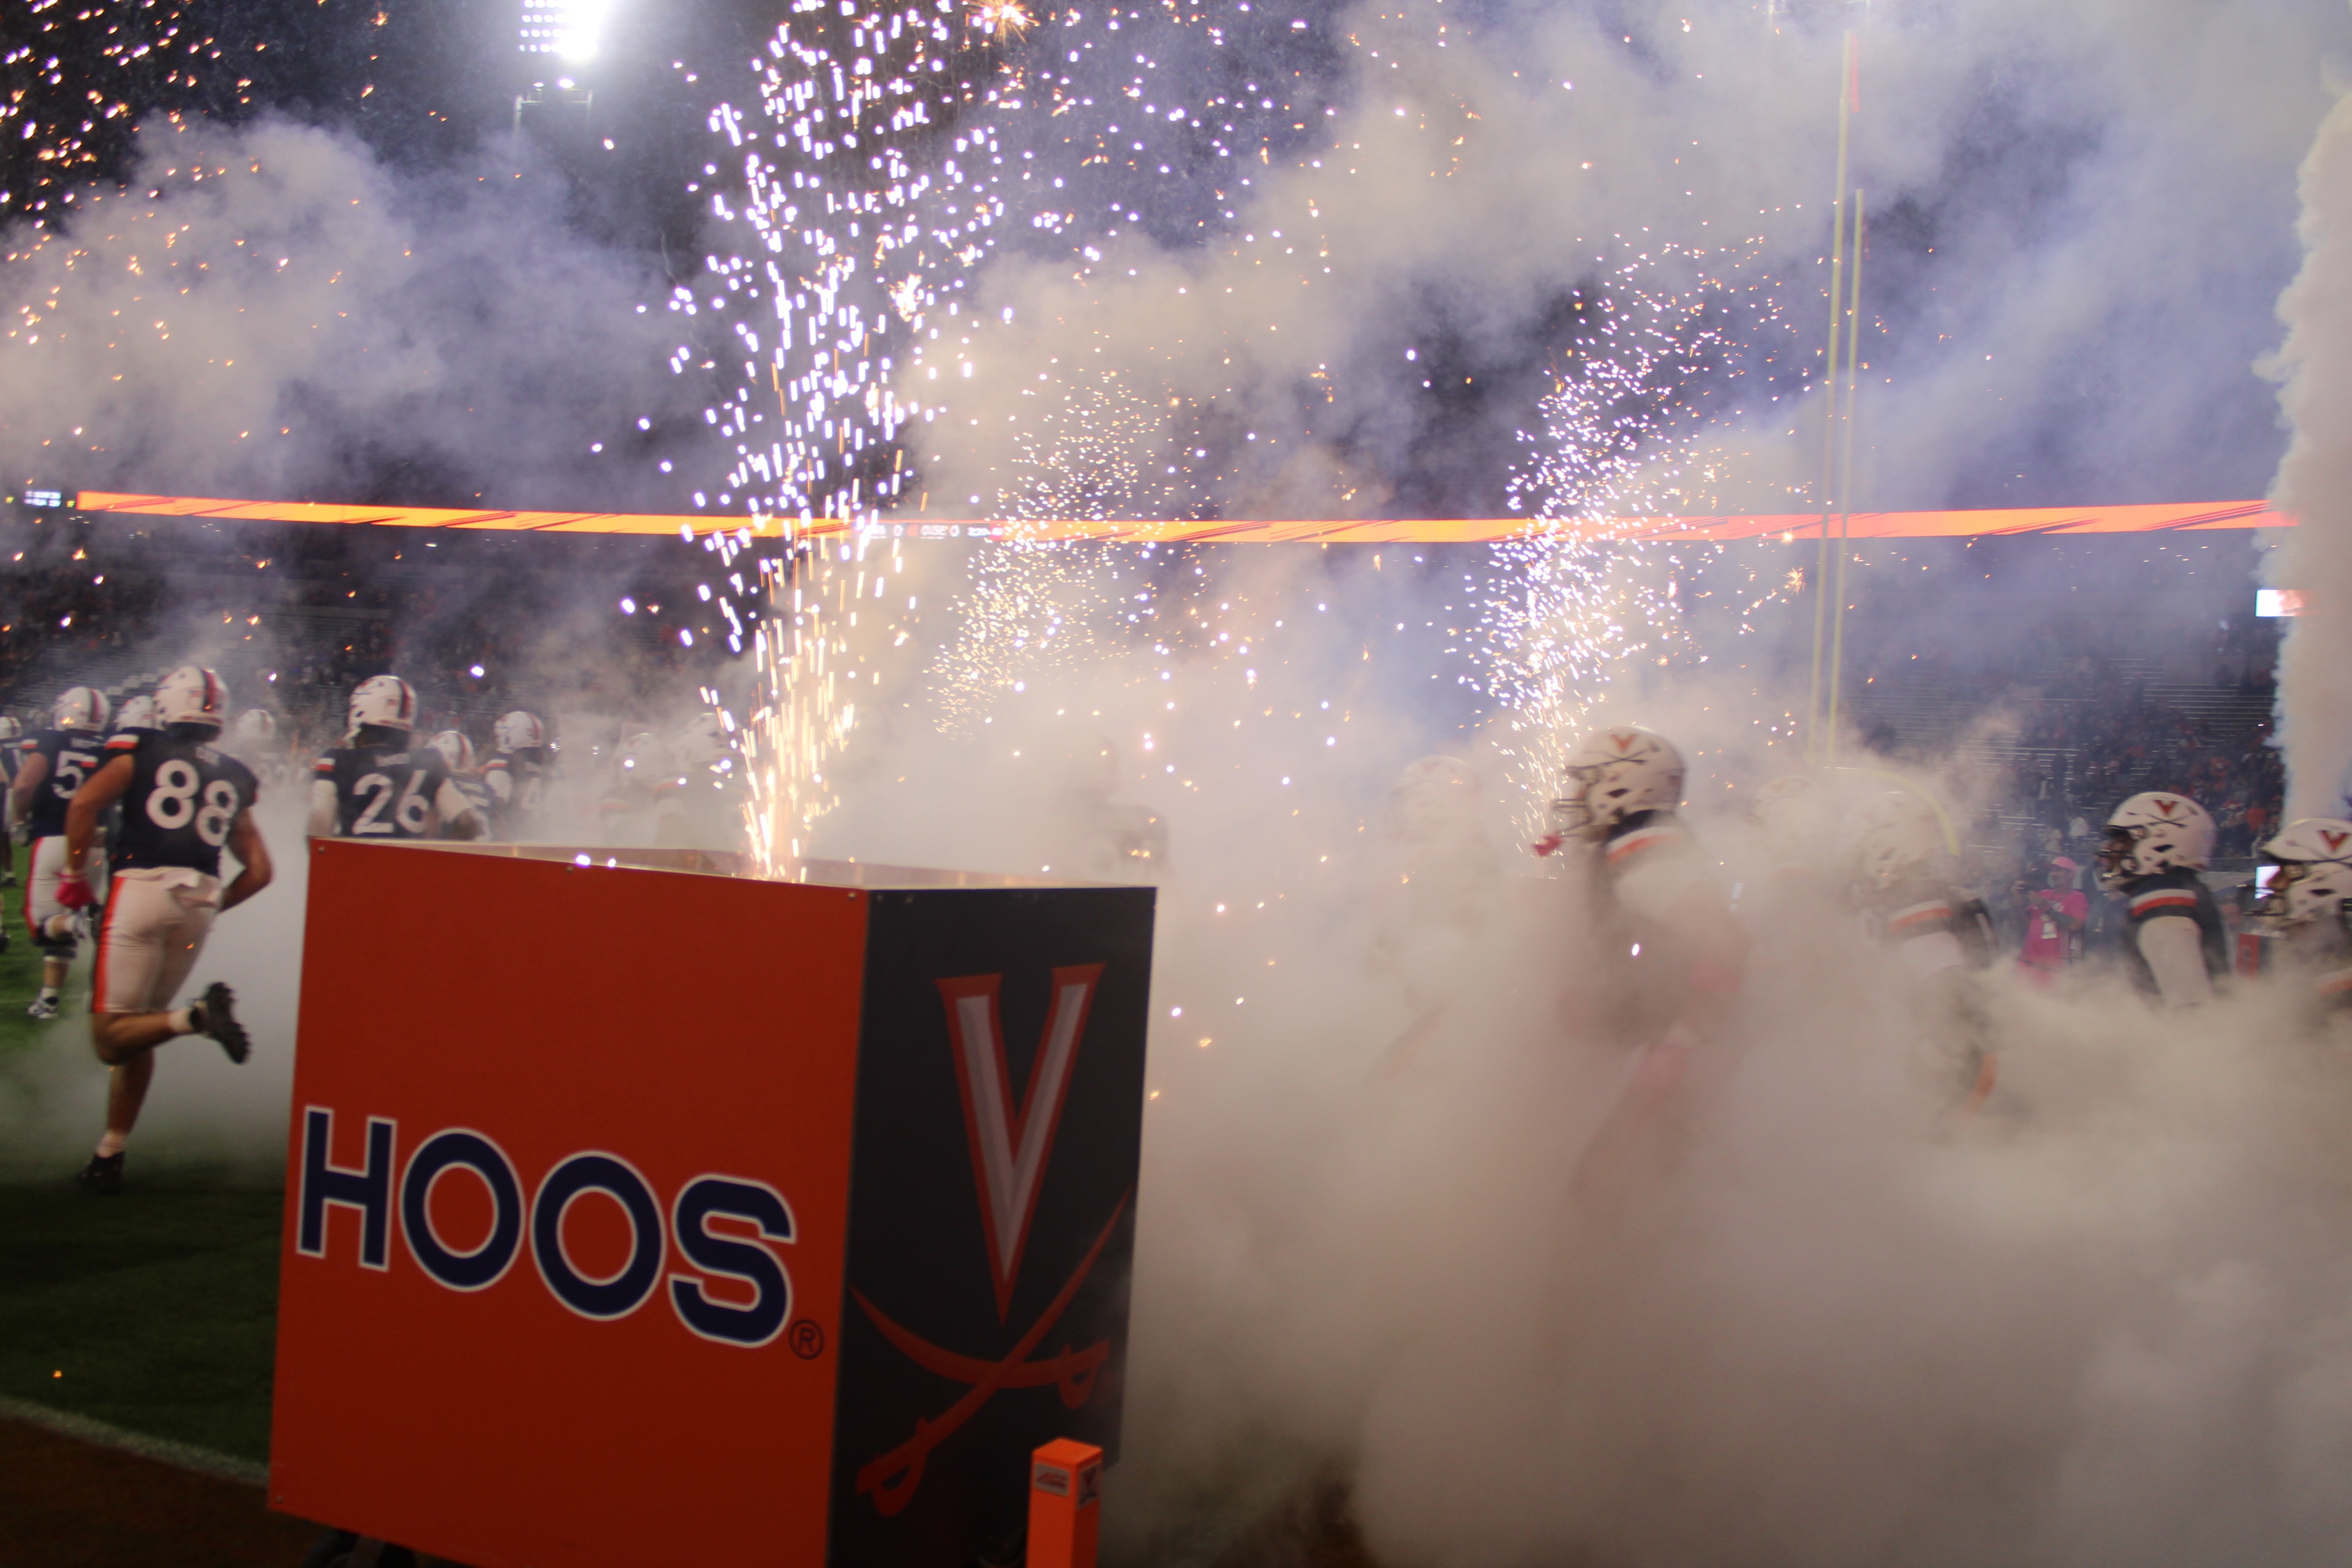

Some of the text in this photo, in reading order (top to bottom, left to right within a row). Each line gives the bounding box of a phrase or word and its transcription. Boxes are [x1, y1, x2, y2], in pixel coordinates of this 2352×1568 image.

[145, 759, 239, 846] 88
[352, 770, 429, 834] 26
[296, 1105, 797, 1348] HOOS
